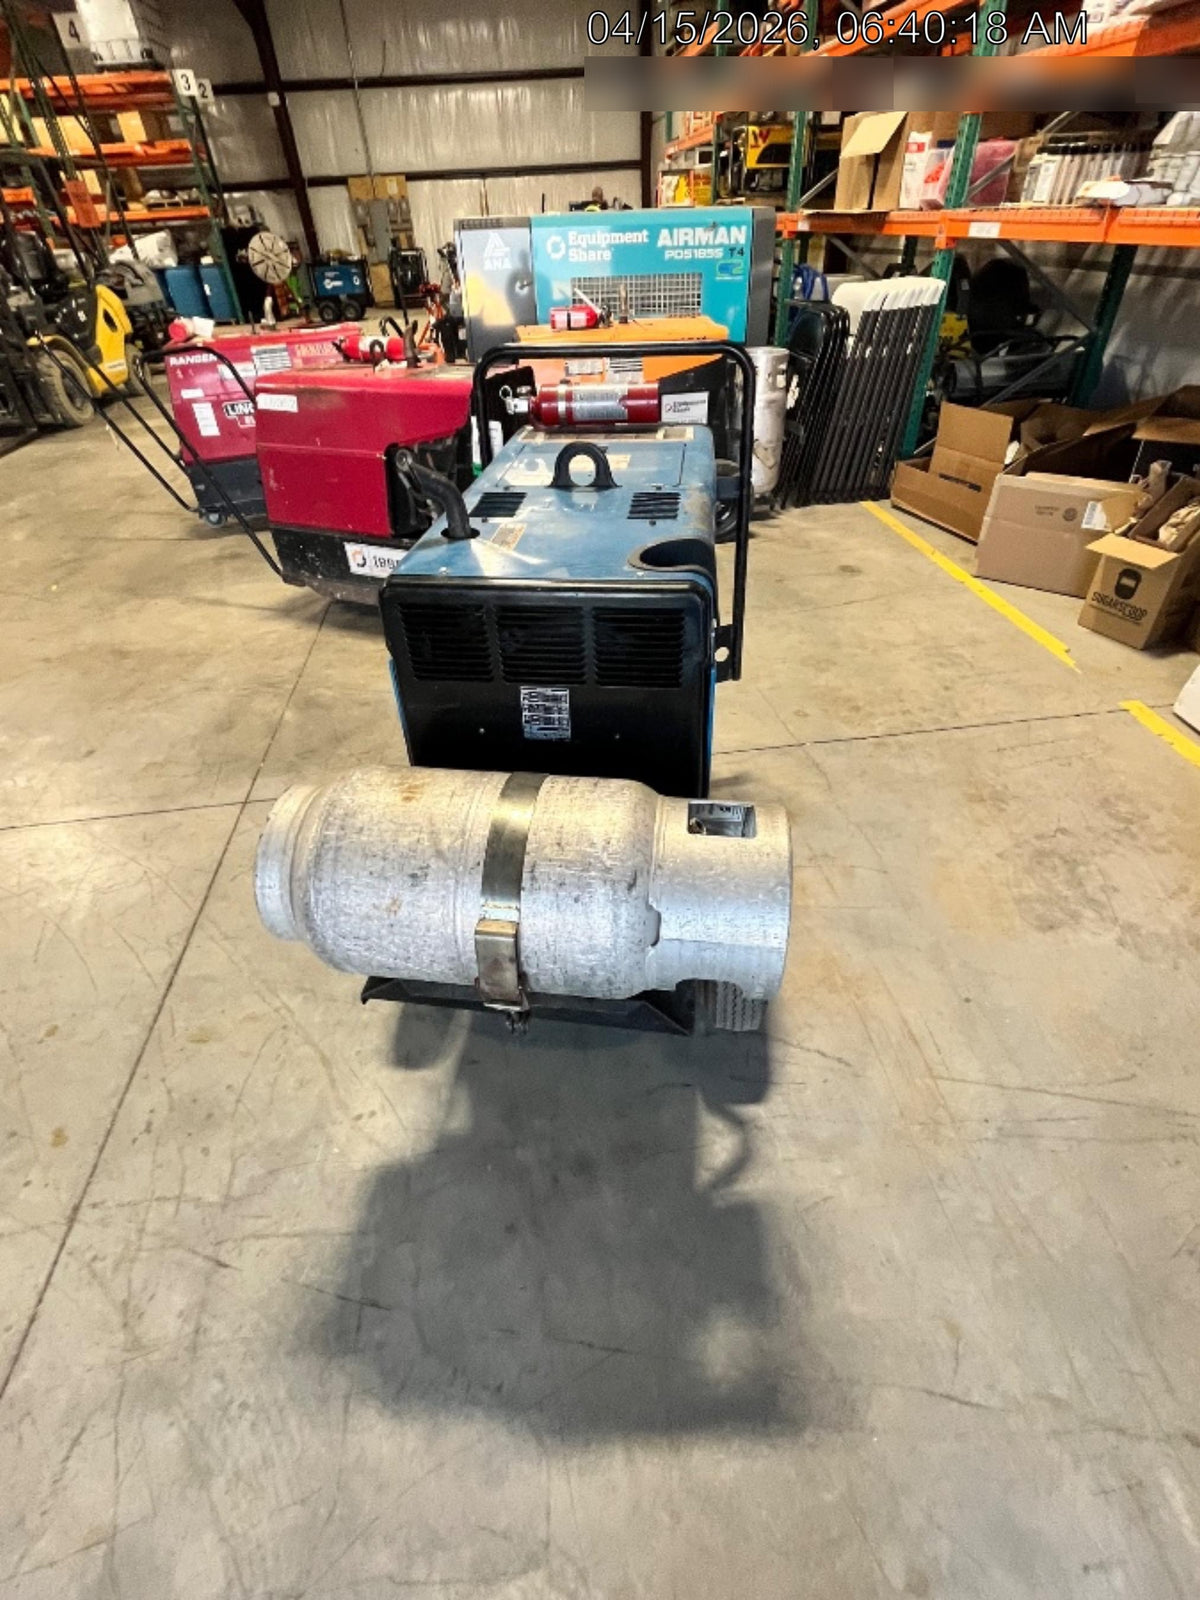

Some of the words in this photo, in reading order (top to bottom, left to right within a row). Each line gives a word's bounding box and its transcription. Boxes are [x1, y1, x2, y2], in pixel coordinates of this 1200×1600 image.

[68, 18, 81, 43] 4
[180, 73, 192, 92] 3
[198, 82, 209, 99] 2
[568, 229, 649, 246] Equipment
[657, 225, 748, 247] AIRMAN
[568, 248, 611, 262] Share
